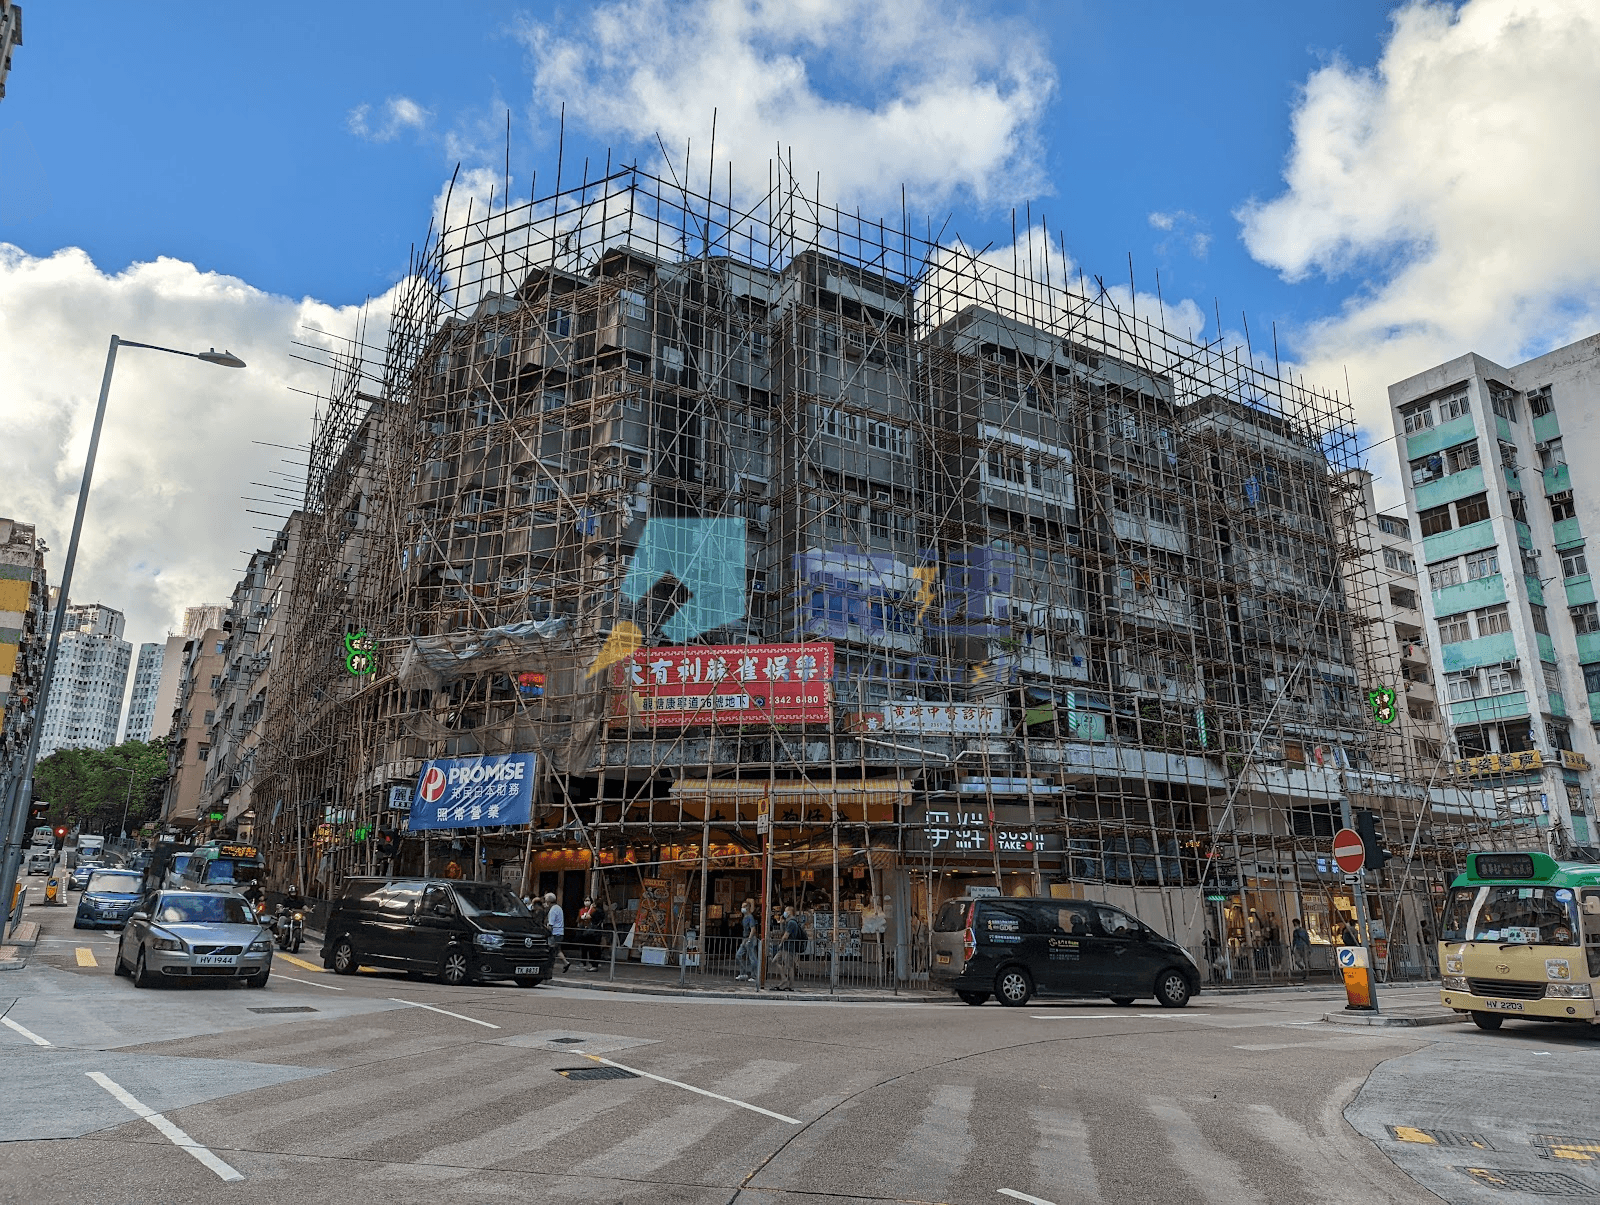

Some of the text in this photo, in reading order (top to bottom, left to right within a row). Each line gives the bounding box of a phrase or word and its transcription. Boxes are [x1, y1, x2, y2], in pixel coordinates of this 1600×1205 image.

[448, 762, 526, 785] PROMISE
[451, 783, 520, 799] 邦民日本財務
[437, 803, 501, 822] 照常營業
[200, 956, 233, 964] HV 1944
[1500, 1002, 1523, 1010] 2203
